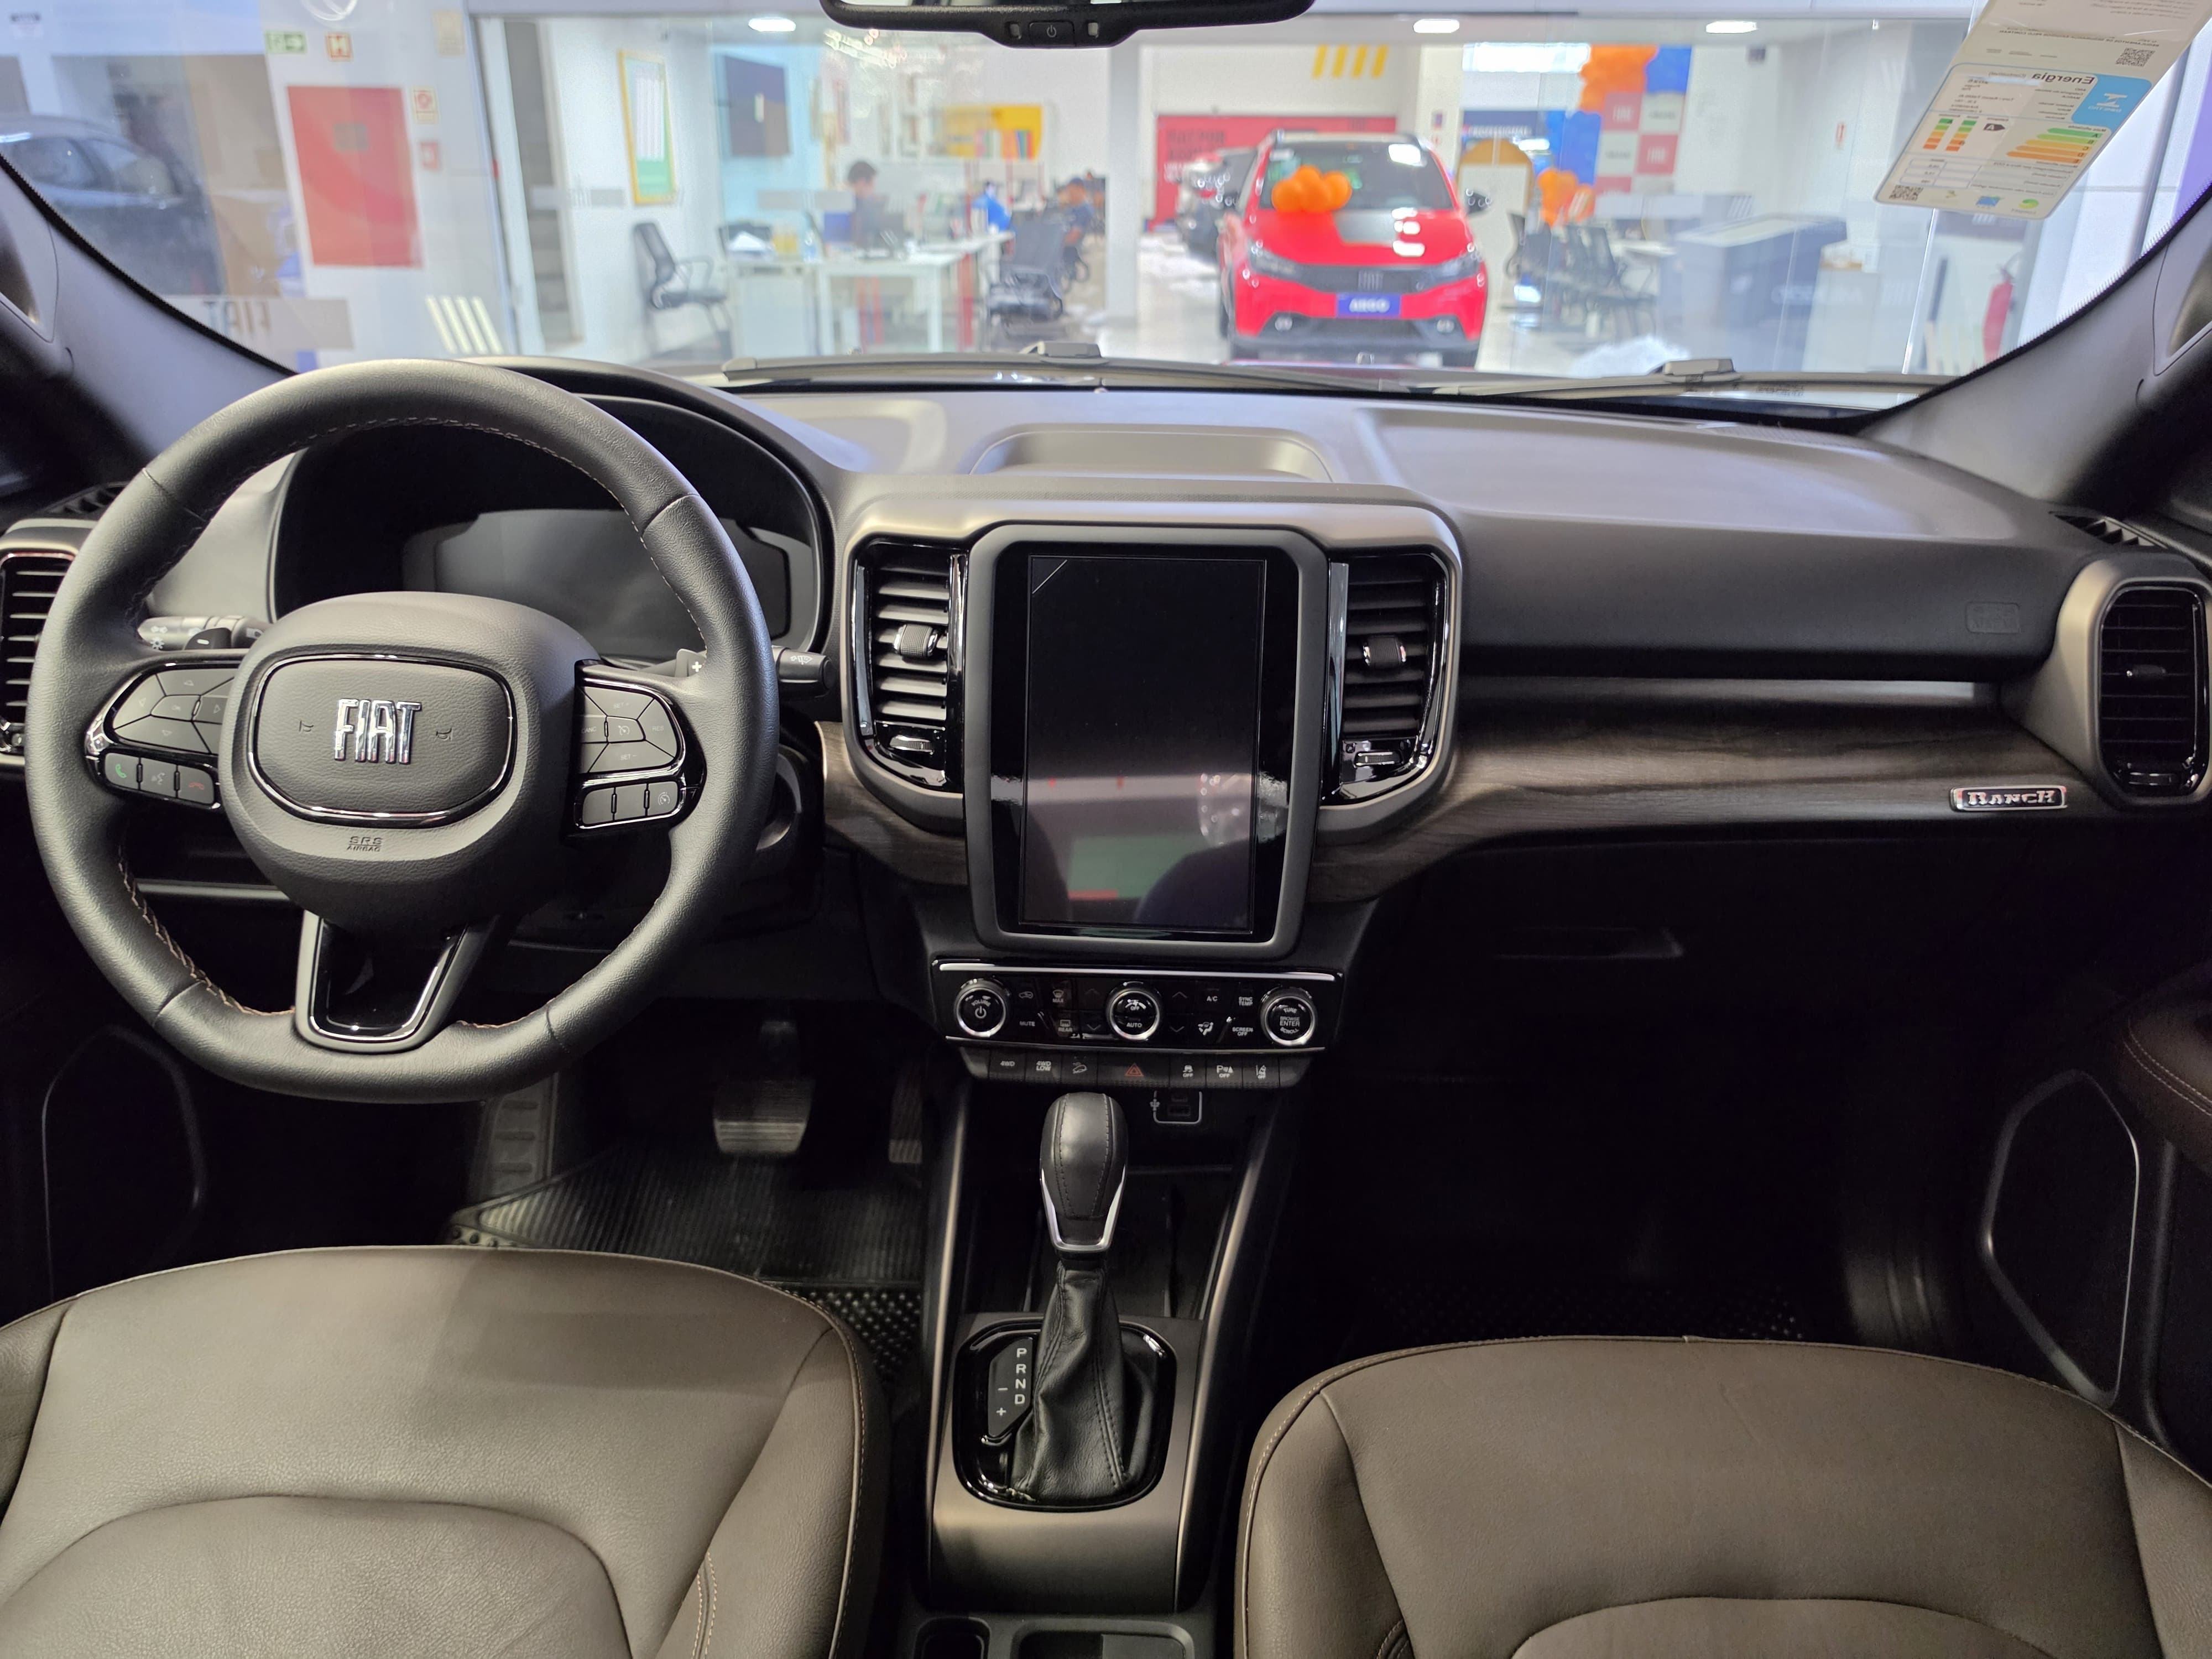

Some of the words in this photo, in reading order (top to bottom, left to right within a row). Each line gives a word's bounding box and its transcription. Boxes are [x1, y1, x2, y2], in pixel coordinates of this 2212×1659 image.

[334, 698, 422, 765] FIAT
[349, 836, 383, 845] SRS
[971, 999, 991, 1007] VOLUME
[1016, 1347, 1027, 1358] P
[1015, 1363, 1026, 1374] R
[1015, 1379, 1026, 1389] N
[1014, 1394, 1025, 1405] D
